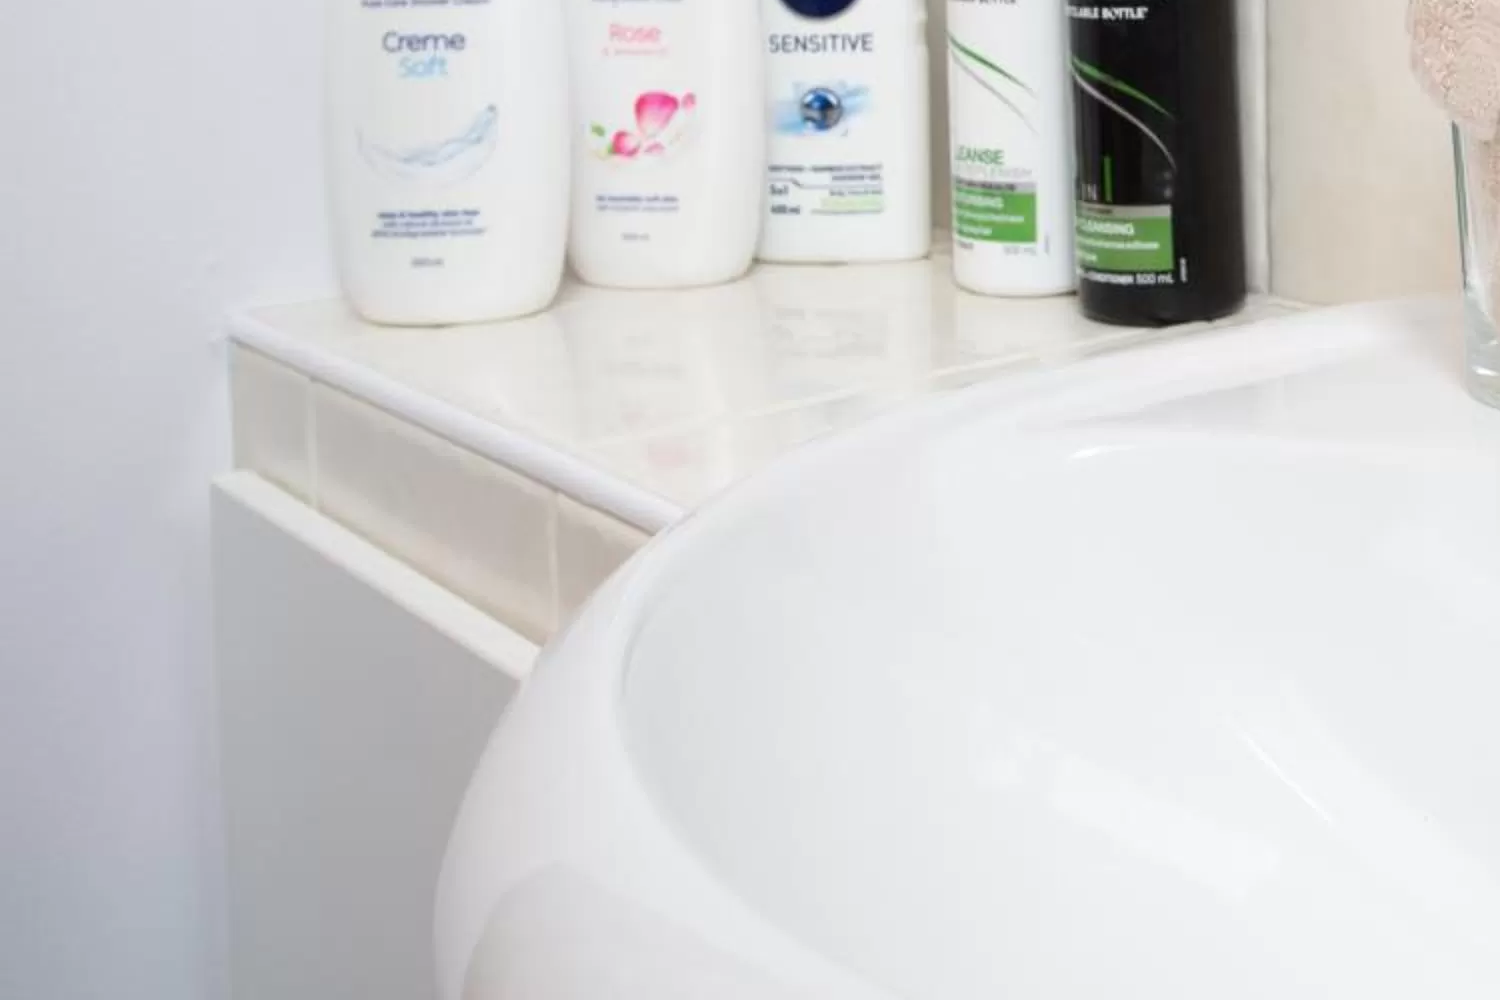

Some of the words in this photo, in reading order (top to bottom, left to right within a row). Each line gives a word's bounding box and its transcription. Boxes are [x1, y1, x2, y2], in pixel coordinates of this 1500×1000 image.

[381, 30, 467, 53] Creme
[609, 22, 662, 43] Rose
[767, 32, 874, 54] SENSITIVE
[399, 55, 449, 79] Soft
